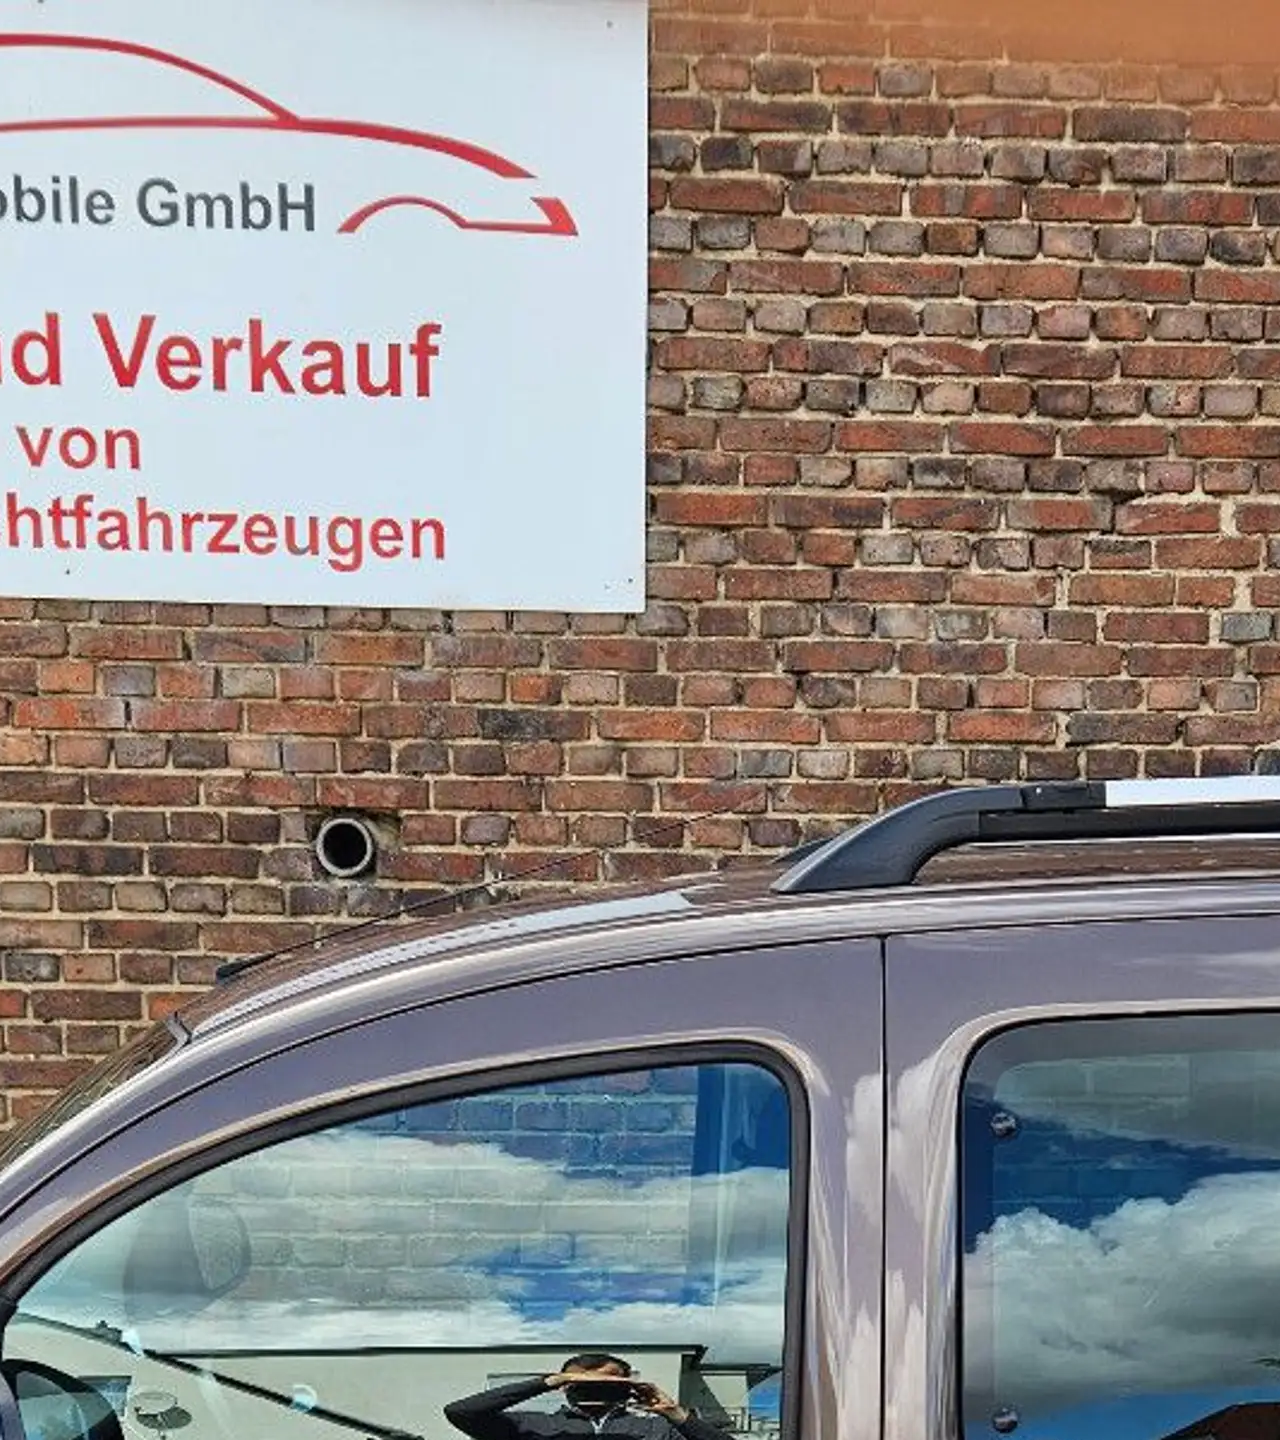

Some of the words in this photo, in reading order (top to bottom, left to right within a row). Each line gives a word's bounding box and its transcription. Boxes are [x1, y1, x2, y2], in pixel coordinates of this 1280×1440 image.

[136, 177, 316, 232] GmbH
[93, 313, 442, 398] Verkauf
[15, 426, 141, 470] von
